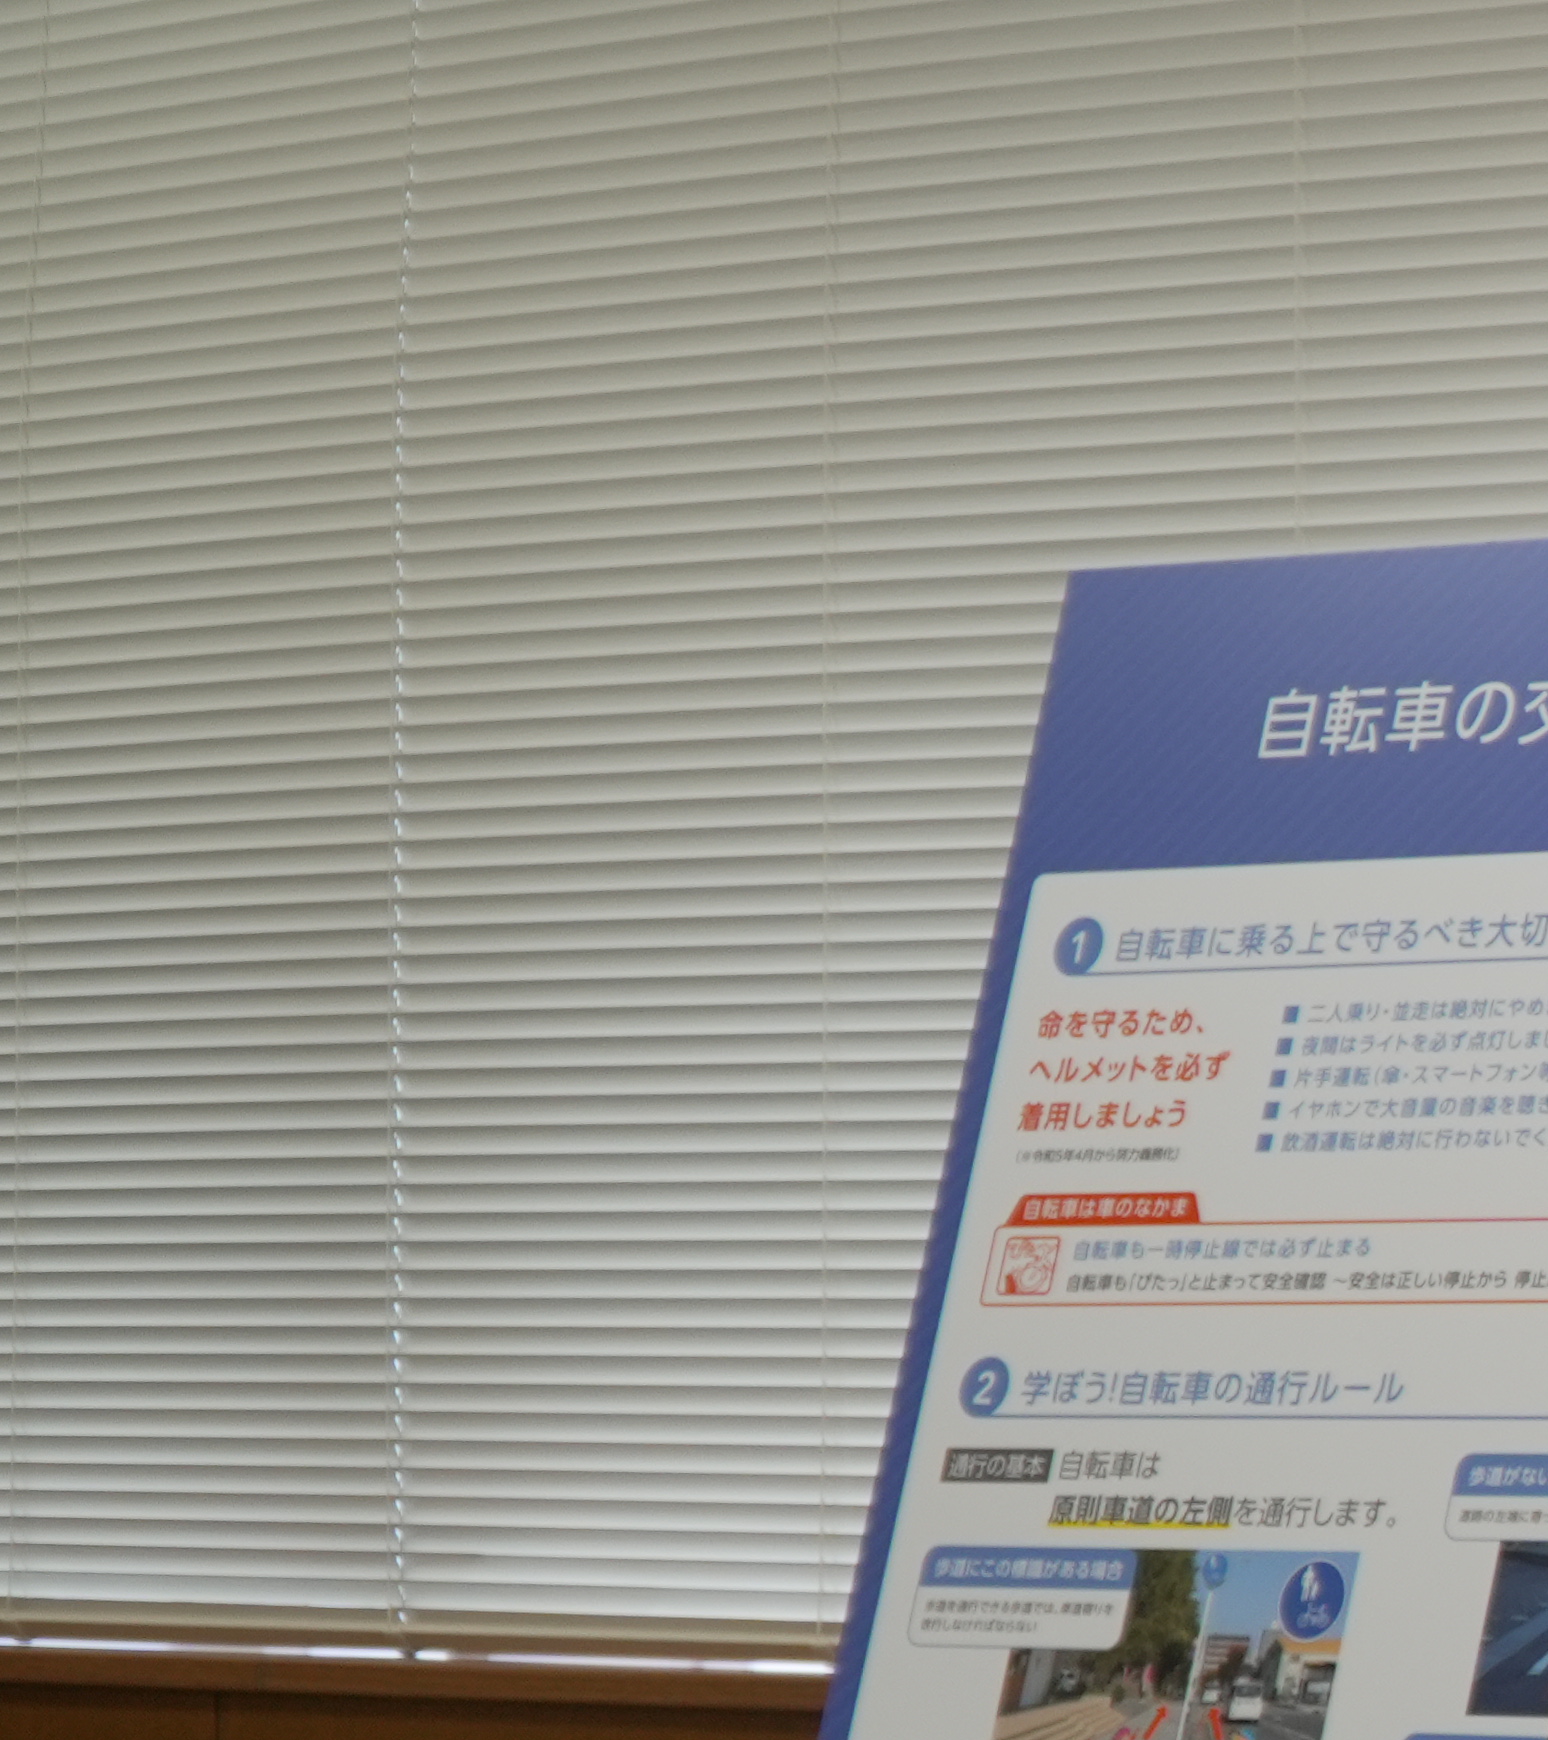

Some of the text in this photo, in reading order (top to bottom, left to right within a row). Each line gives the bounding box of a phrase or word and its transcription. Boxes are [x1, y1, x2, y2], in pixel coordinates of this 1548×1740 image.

[1070, 932, 1087, 963] 1
[1038, 1009, 1206, 1040] 命を守るため、
[1029, 1051, 1231, 1084] ヘルメットを必ず
[1017, 1099, 1188, 1132] 着用しましょう
[1023, 1197, 1189, 1220] 自転車は車のなかま
[972, 1372, 993, 1405] 2
[1021, 1368, 1405, 1407] 学ぼう!自転車の通行ルール
[946, 1453, 1050, 1481] 通行の基本
[1058, 1450, 1161, 1481] 自転車は
[1047, 1495, 1400, 1529] 原則車道の左側を通行します。
